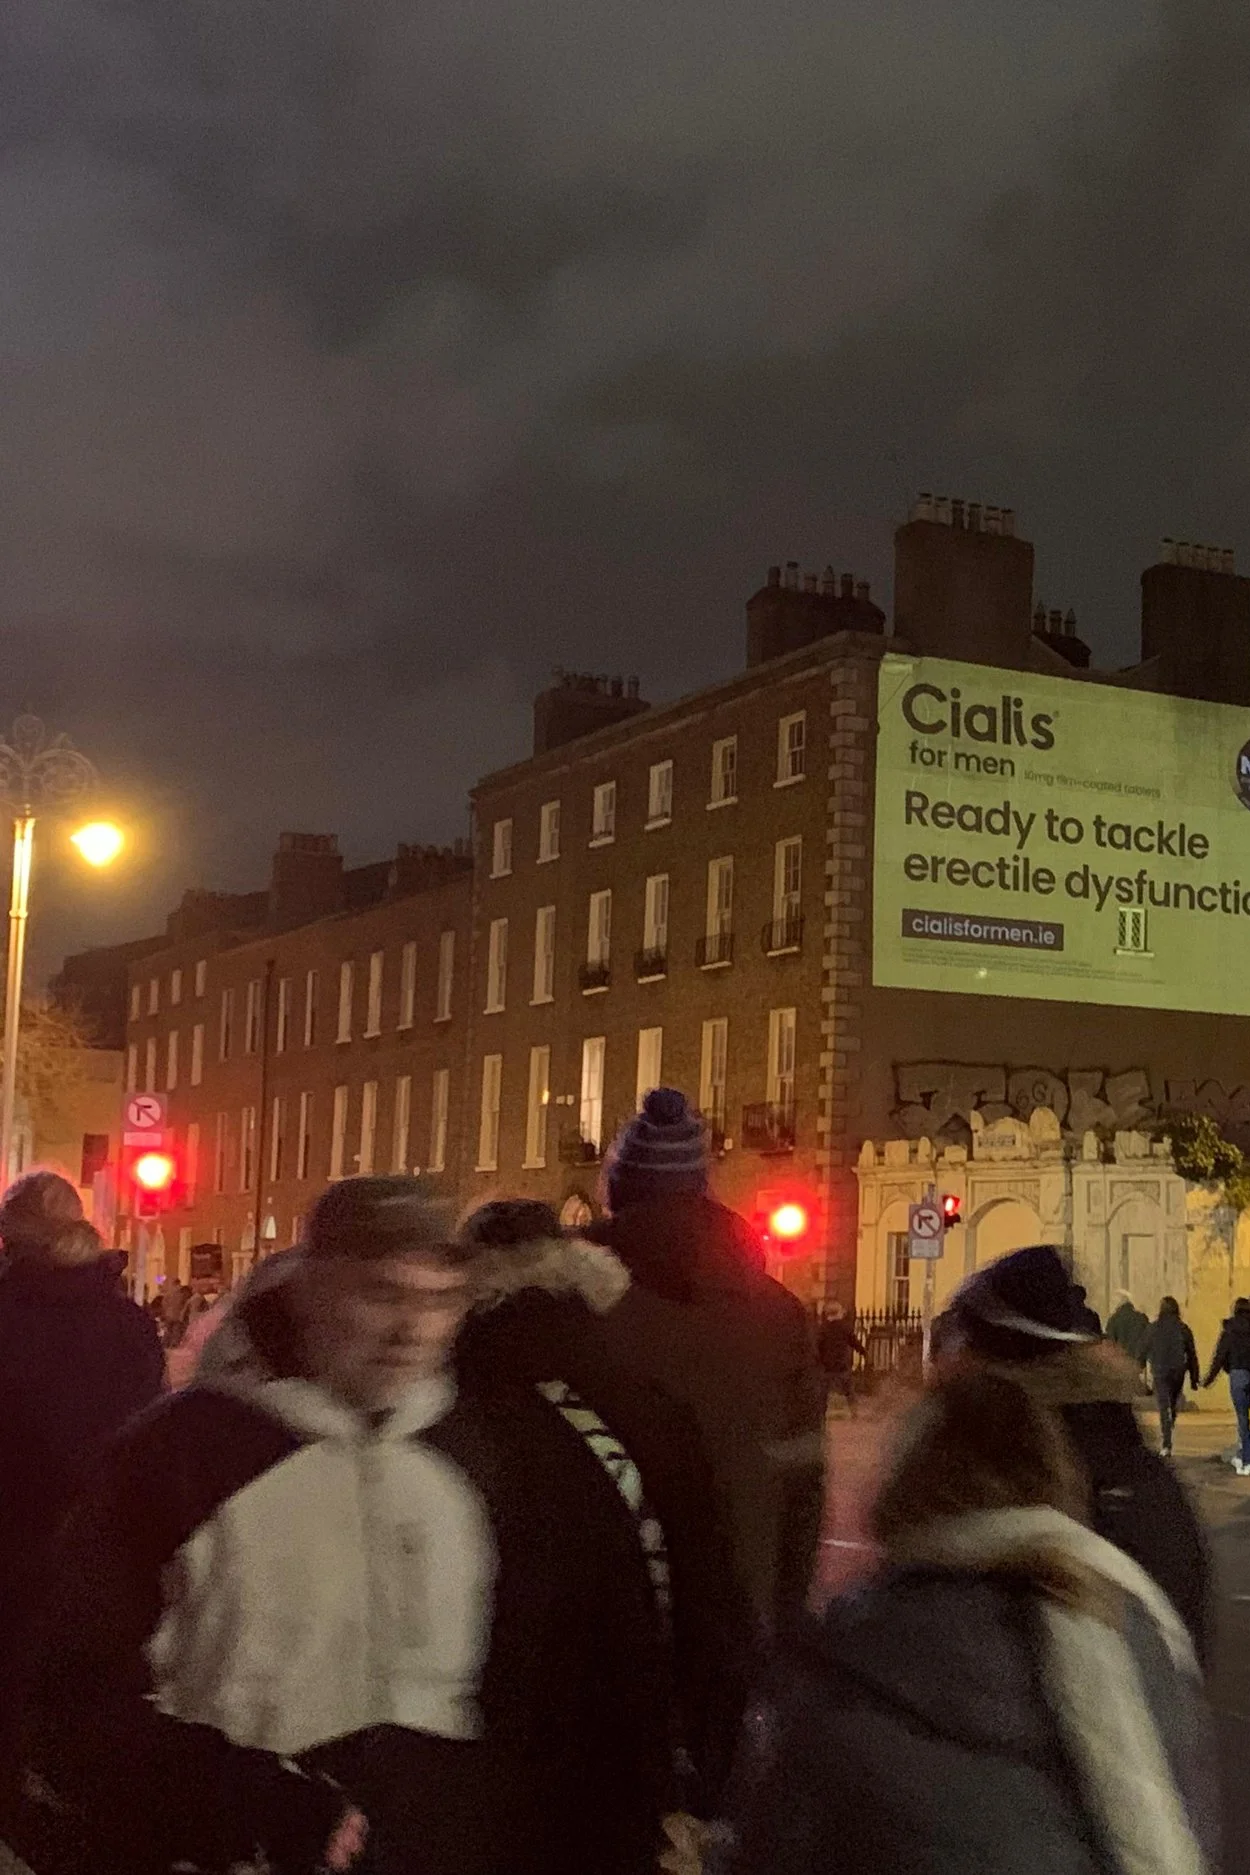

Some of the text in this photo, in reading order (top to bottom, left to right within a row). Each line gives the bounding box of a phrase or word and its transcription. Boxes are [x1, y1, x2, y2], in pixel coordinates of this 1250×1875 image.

[902, 683, 1055, 750] Cialis
[909, 740, 1015, 777] for men
[905, 790, 1209, 859] Ready to tackle
[904, 853, 1056, 895] erectile
[911, 914, 1056, 945] cialisformen.ie
